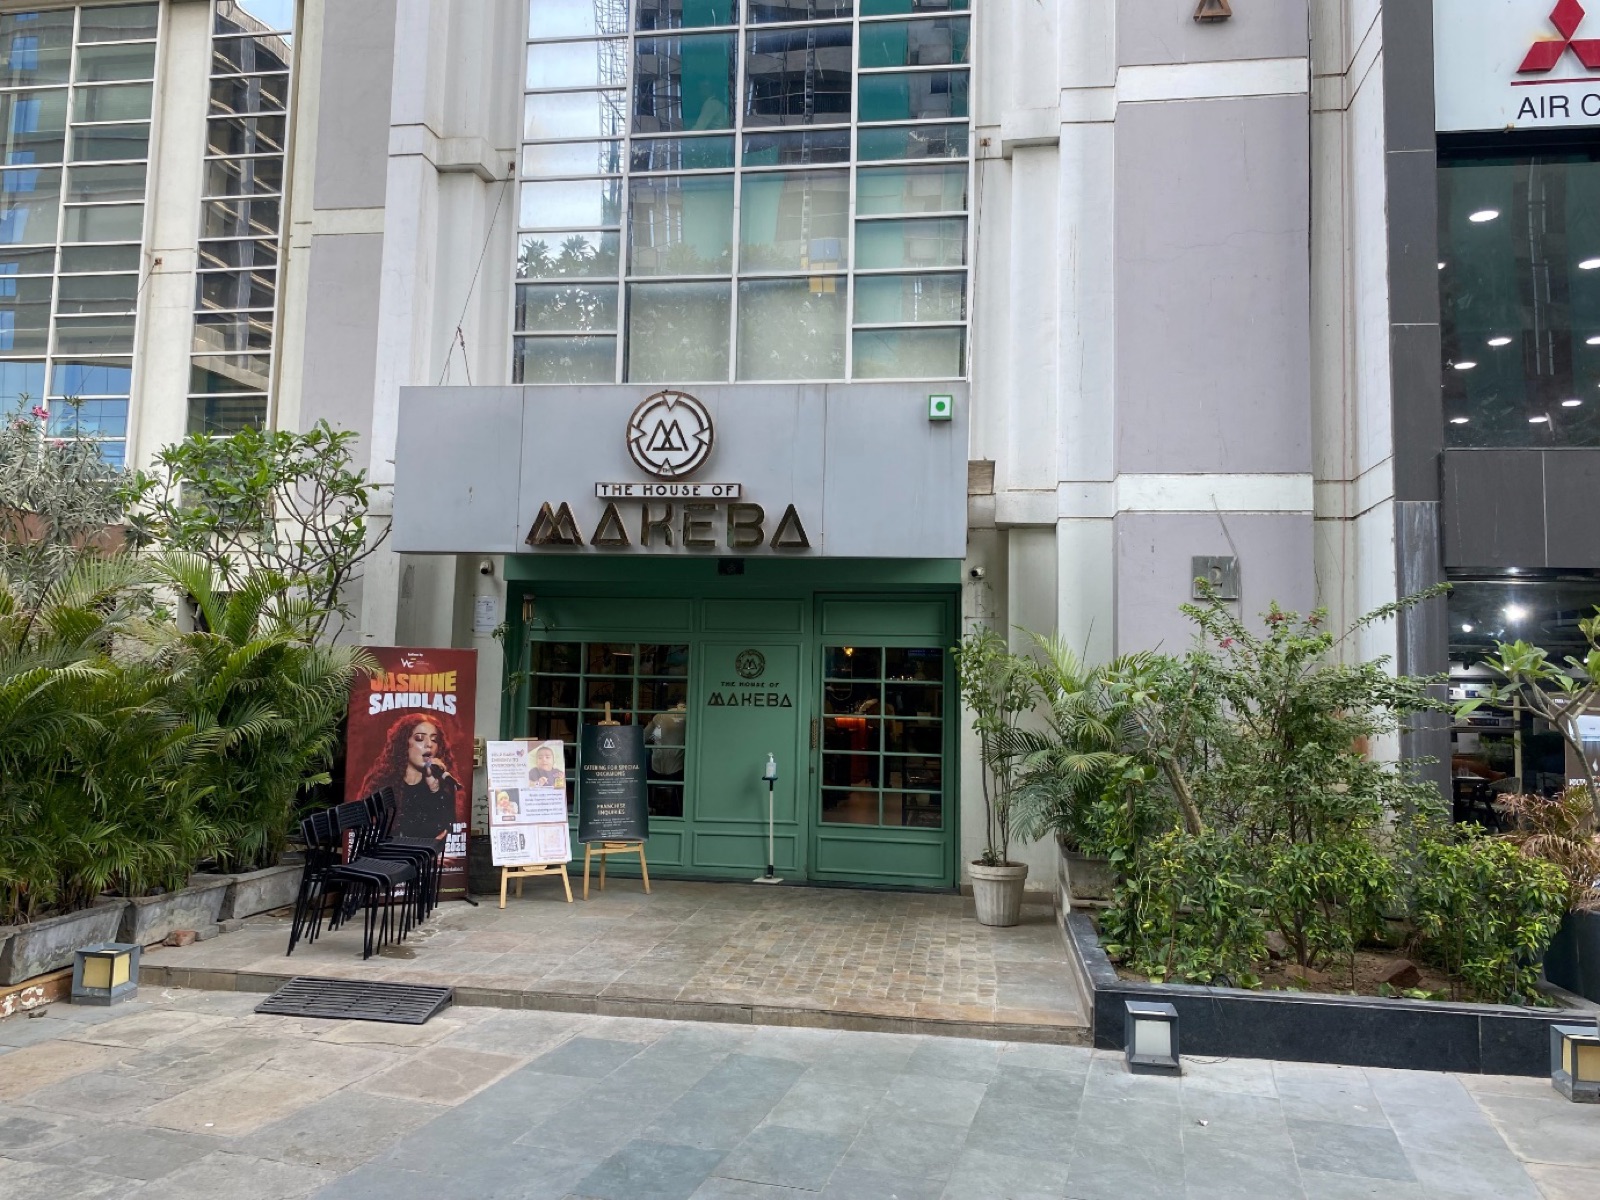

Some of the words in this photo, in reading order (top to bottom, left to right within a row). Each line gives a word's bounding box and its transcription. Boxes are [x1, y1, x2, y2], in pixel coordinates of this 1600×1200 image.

[1517, 95, 1570, 119] AIR
[601, 484, 633, 496] THE
[642, 484, 701, 496] HOUSE
[711, 485, 734, 496] OF
[524, 501, 811, 548] MAKEBA
[370, 670, 457, 692] JASMINE
[368, 692, 457, 715] SANDLAS
[707, 692, 792, 708] MAKEBA
[445, 832, 467, 843] April
